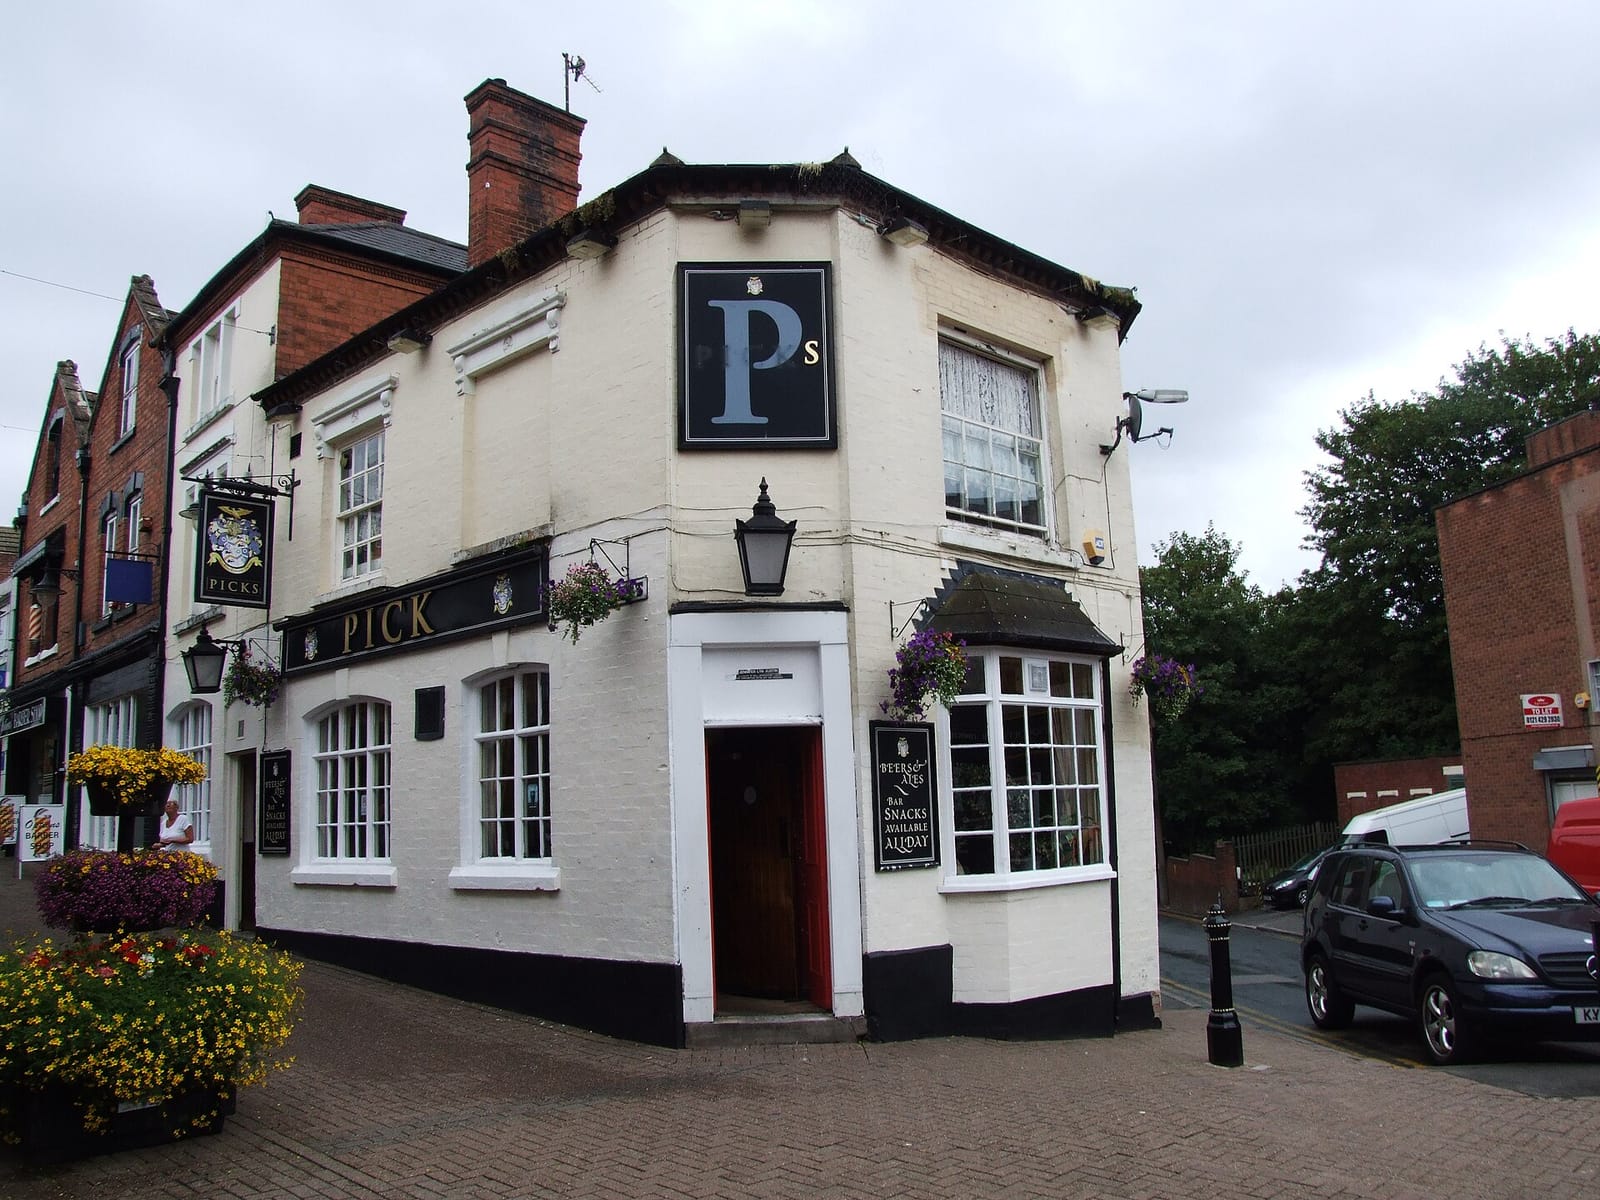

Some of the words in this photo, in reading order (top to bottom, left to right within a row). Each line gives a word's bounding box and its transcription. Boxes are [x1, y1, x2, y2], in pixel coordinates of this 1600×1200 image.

[210, 579, 259, 594] PICKS
[342, 591, 434, 654] PICK
[880, 762, 912, 775] BEERS
[901, 774, 924, 788] ALES
[887, 797, 904, 806] BAR
[884, 807, 927, 820] SNACKS
[885, 823, 928, 833] AVAILABLE
